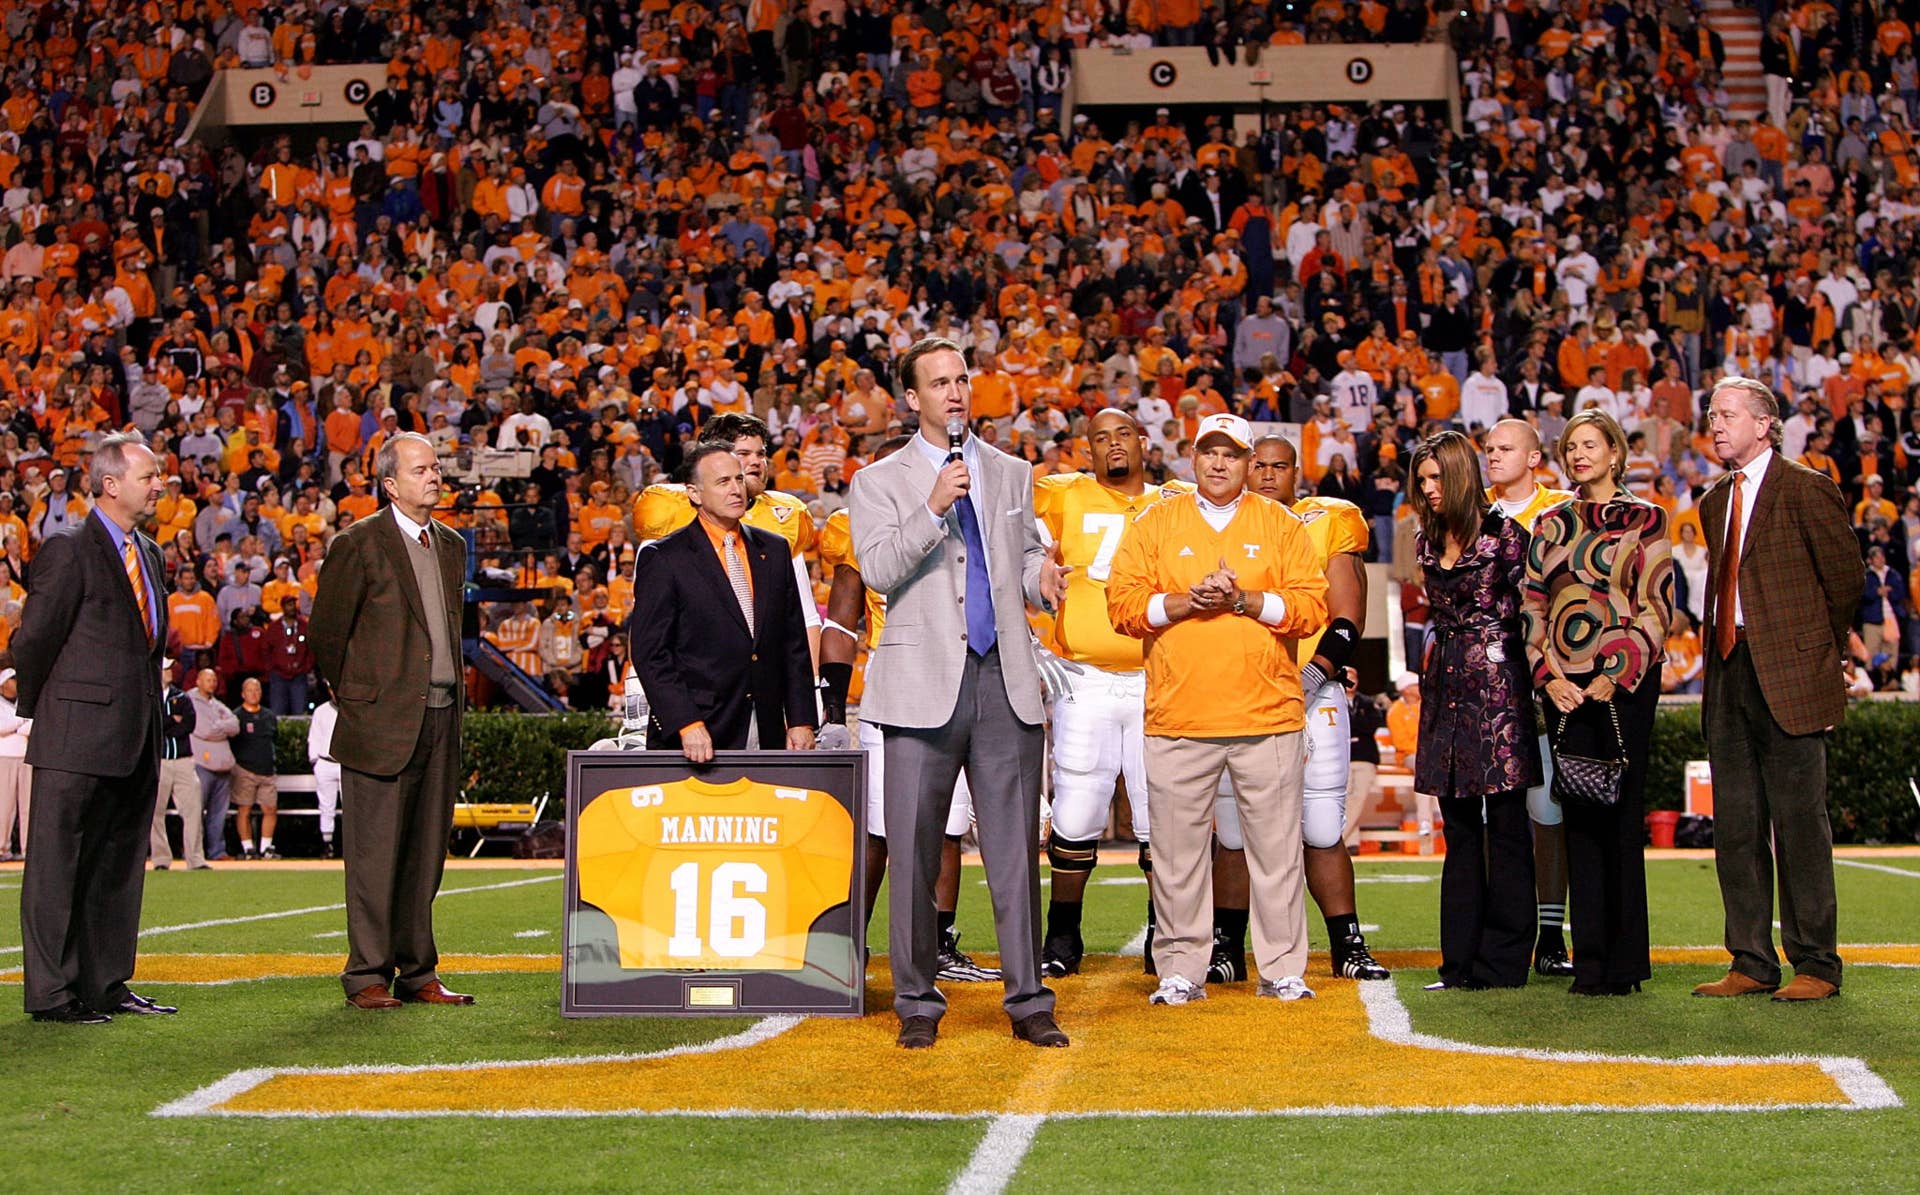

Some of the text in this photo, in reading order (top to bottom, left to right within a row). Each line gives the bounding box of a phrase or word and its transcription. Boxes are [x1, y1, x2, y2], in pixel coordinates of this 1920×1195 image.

[1153, 65, 1170, 83] C
[1350, 61, 1368, 81] D
[255, 86, 271, 104] B
[349, 83, 364, 101] C
[1349, 383, 1369, 407] 18
[1215, 417, 1235, 430] T
[1082, 513, 1125, 581] 7
[1243, 543, 1261, 559] T
[1318, 706, 1339, 726] T
[660, 815, 778, 845] MANNING
[668, 861, 768, 958] 16
